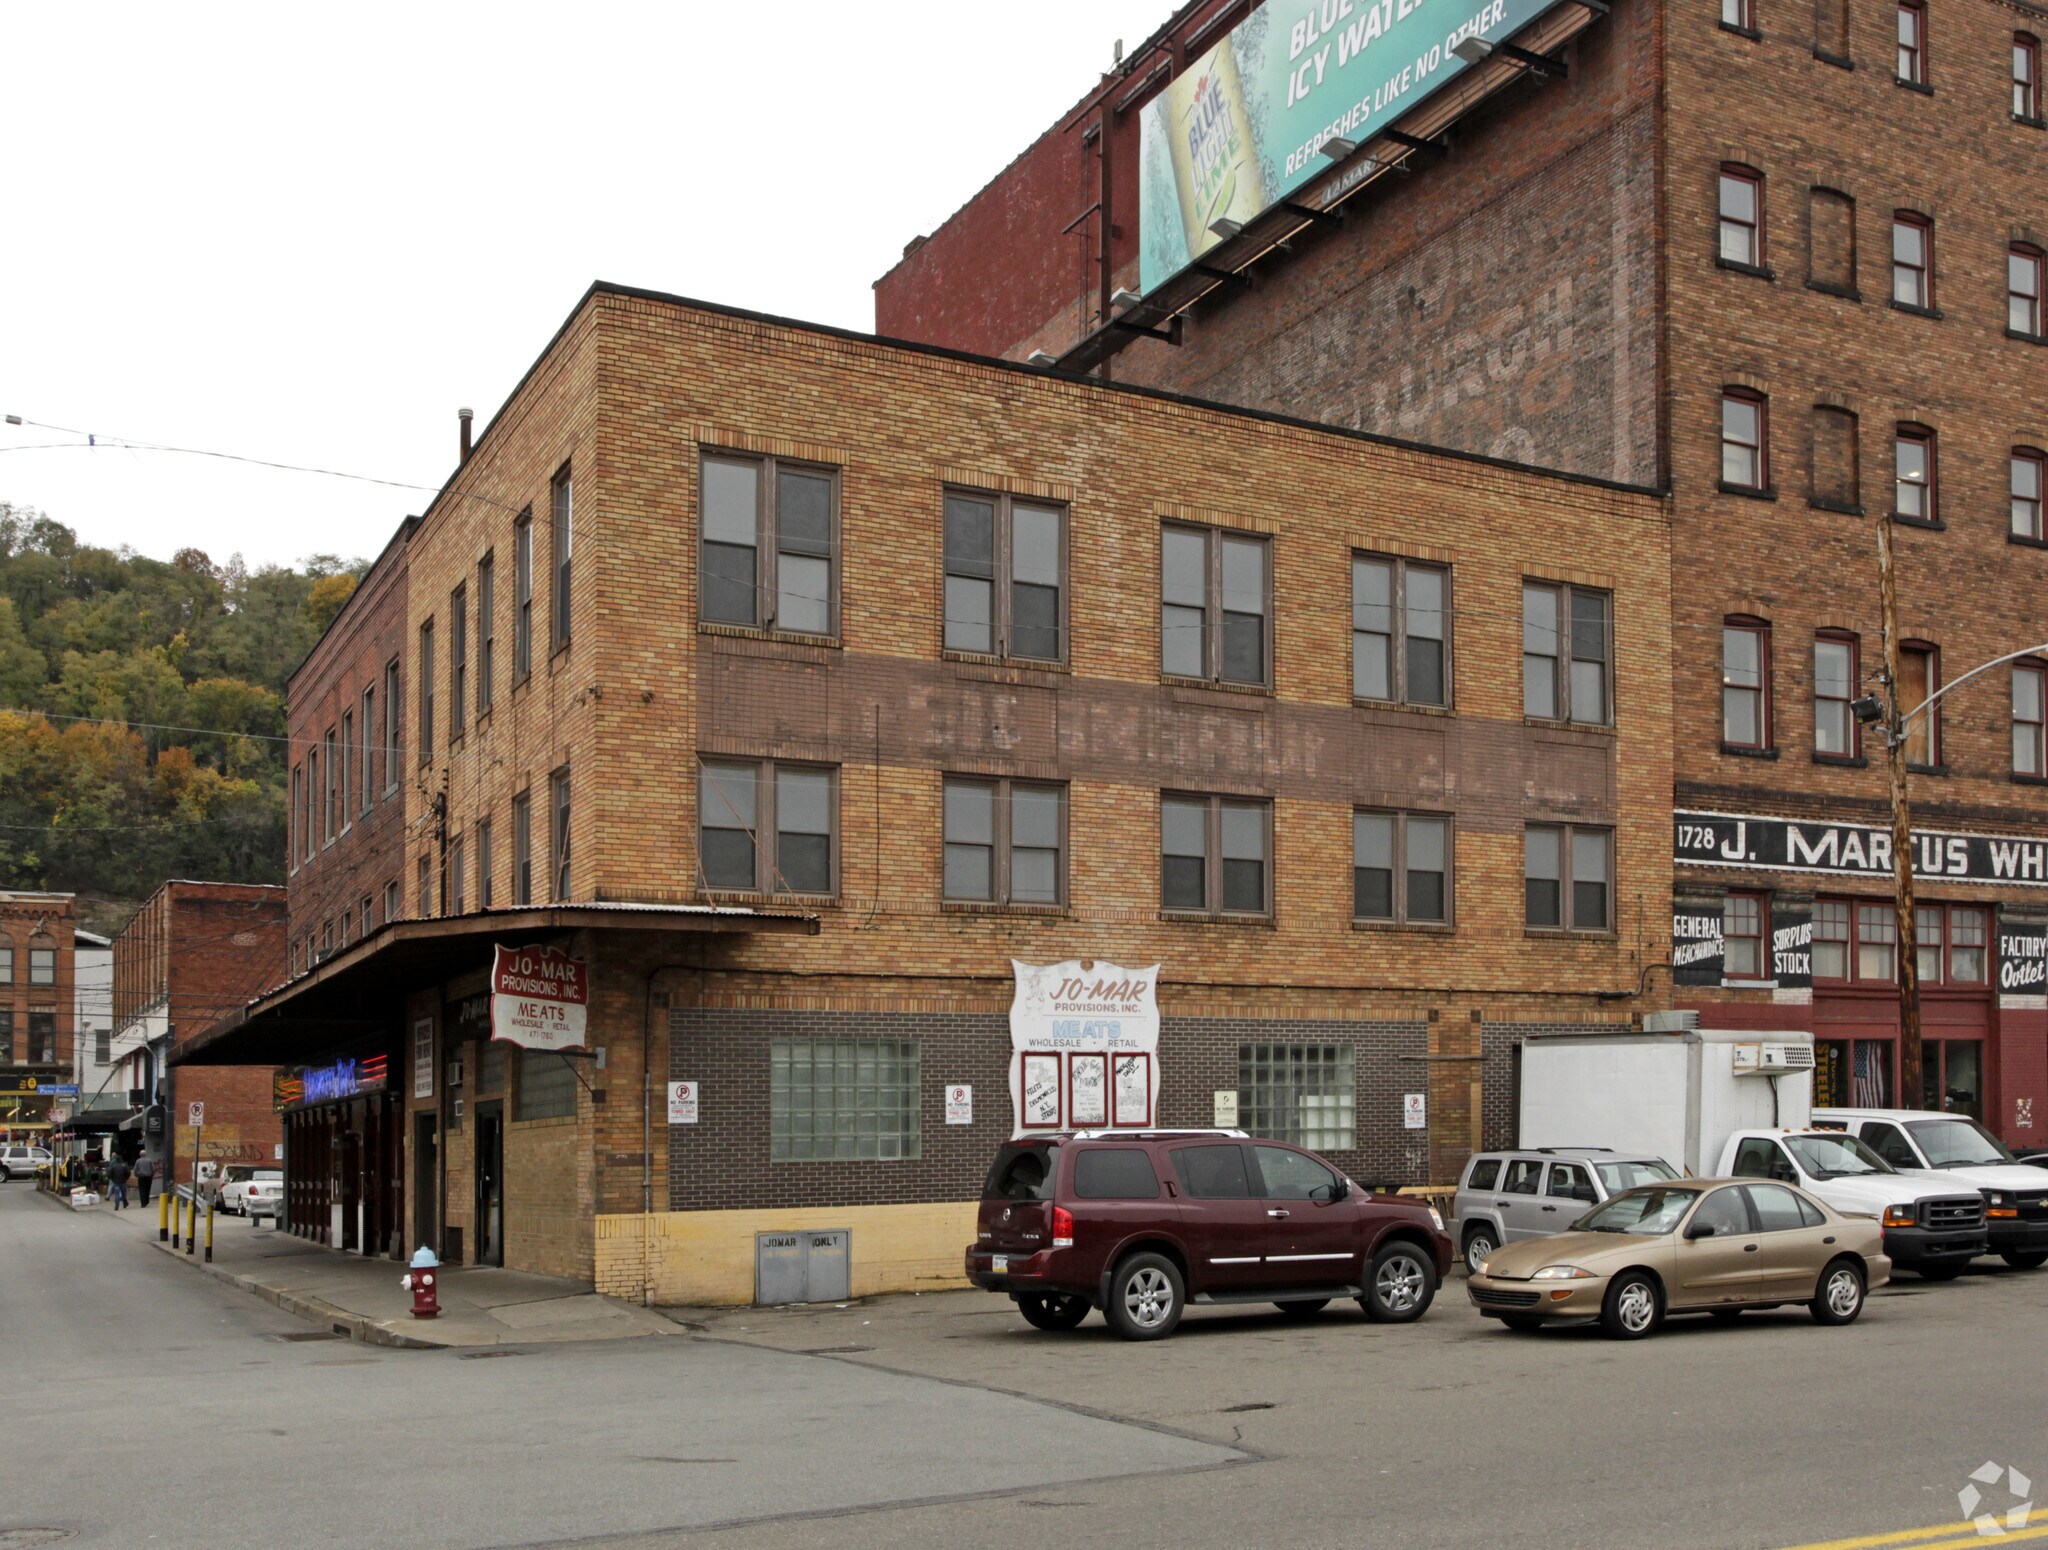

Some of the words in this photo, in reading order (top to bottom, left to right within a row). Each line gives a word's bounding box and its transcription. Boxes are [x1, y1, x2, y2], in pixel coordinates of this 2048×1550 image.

[1287, 43, 1331, 109] ICY
[1337, 0, 1424, 68] WATE
[1188, 76, 1224, 161] BLUE
[1284, 95, 1371, 178] REFRESHES
[1374, 64, 1412, 112] LIKE
[1415, 44, 1441, 83] NO
[1191, 99, 1234, 197] LIGHT
[1194, 128, 1241, 220] LIME
[1325, 160, 1372, 201] LAMAR
[1678, 825, 1716, 850] 1728
[1720, 821, 1756, 861] J.
[1988, 840, 2048, 880] WH
[1673, 915, 1723, 939] GENERAL
[1772, 923, 1812, 952] SURPLUS
[2001, 935, 2047, 958] FACTORY
[508, 955, 577, 983] JO-MAR
[1774, 952, 1810, 975] STOCK
[2001, 959, 2045, 989] Outlet
[563, 984, 581, 1000] INC.
[1049, 978, 1148, 1002] JO-MAR
[517, 1002, 565, 1021] MEATS
[1054, 1002, 1120, 1013] PROVISIONS,
[1121, 1004, 1142, 1013] INC.
[511, 1017, 545, 1029] WHOLESALE
[552, 1022, 571, 1032] RETAIL
[1052, 1020, 1122, 1039] MEATS
[1028, 1038, 1082, 1048] WHOLESALE
[1107, 1039, 1139, 1048] RETAIL
[765, 1237, 797, 1248] JOMAR
[814, 1236, 838, 1247] ONLY
